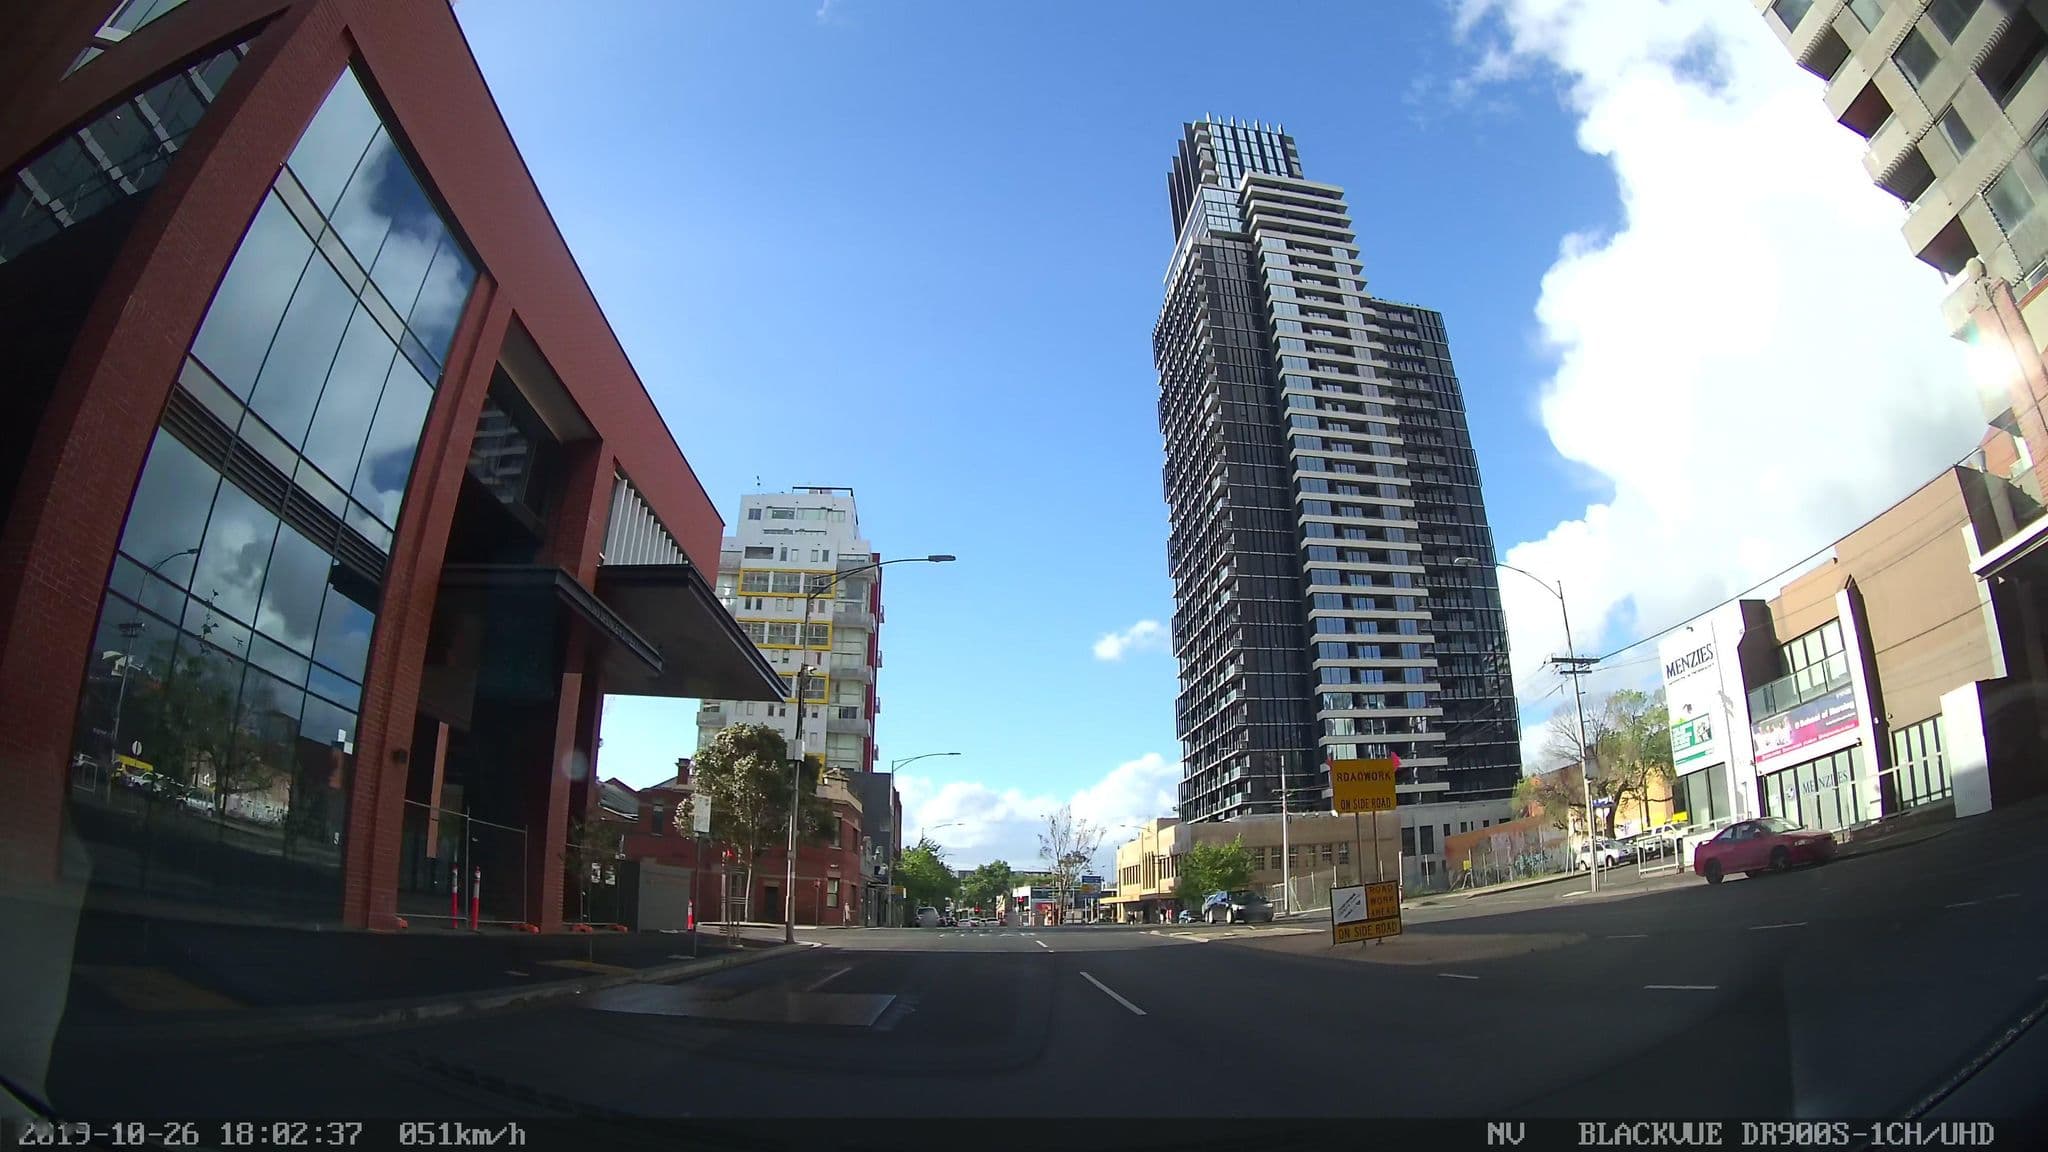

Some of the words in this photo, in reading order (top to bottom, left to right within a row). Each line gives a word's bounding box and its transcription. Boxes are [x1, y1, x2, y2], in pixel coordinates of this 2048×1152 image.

[1666, 643, 1714, 679] MENZIES
[1336, 771, 1391, 782] ROADWORK
[1340, 799, 1351, 810] ON
[1353, 798, 1369, 809] SIDE
[1371, 797, 1391, 809] ROAD
[1338, 927, 1350, 940] ON
[1354, 925, 1373, 938] SIDE
[1375, 921, 1398, 934] ROAD
